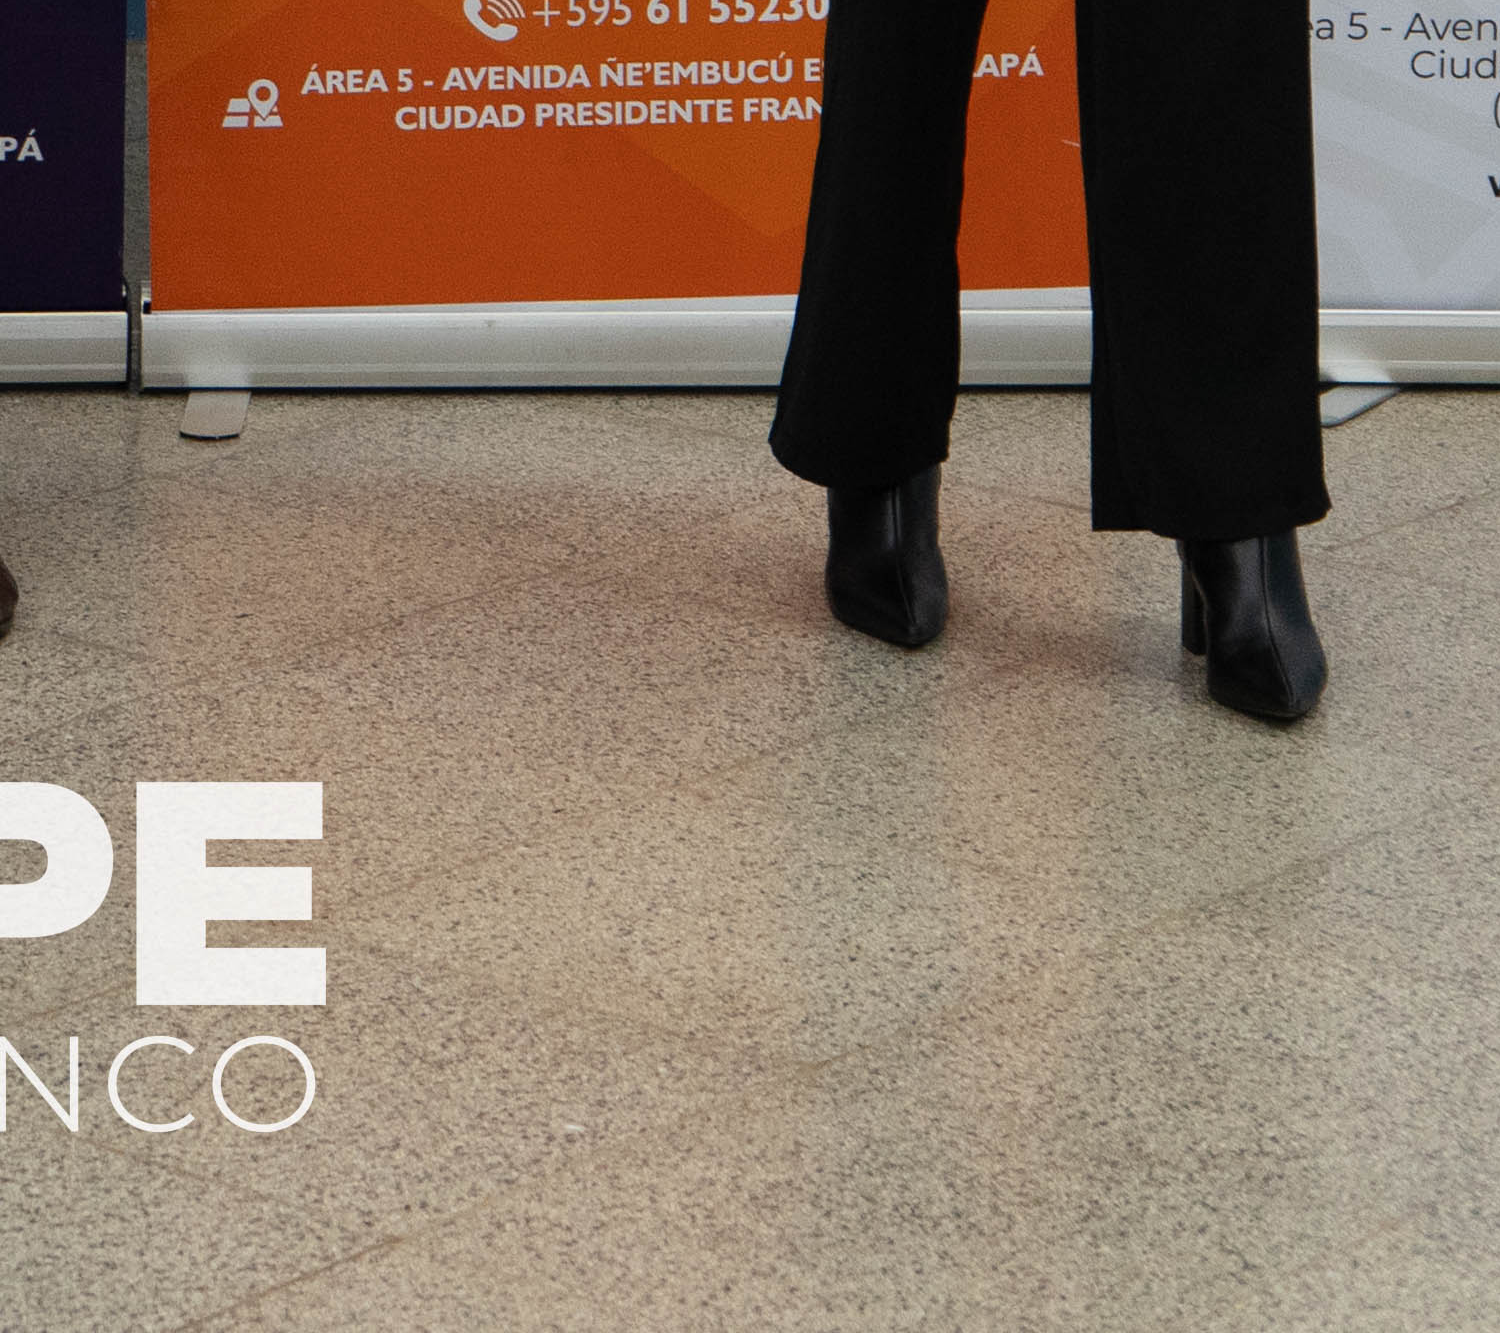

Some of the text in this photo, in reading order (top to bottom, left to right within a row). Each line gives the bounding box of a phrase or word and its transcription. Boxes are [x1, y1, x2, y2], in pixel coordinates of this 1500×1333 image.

[1348, 12, 1368, 40] 5
[301, 64, 389, 95] ÁREA
[398, 69, 413, 92] 5
[443, 65, 591, 91] AVENIDA
[395, 97, 822, 130] CIUDAD PRESIDENTE FRAN
